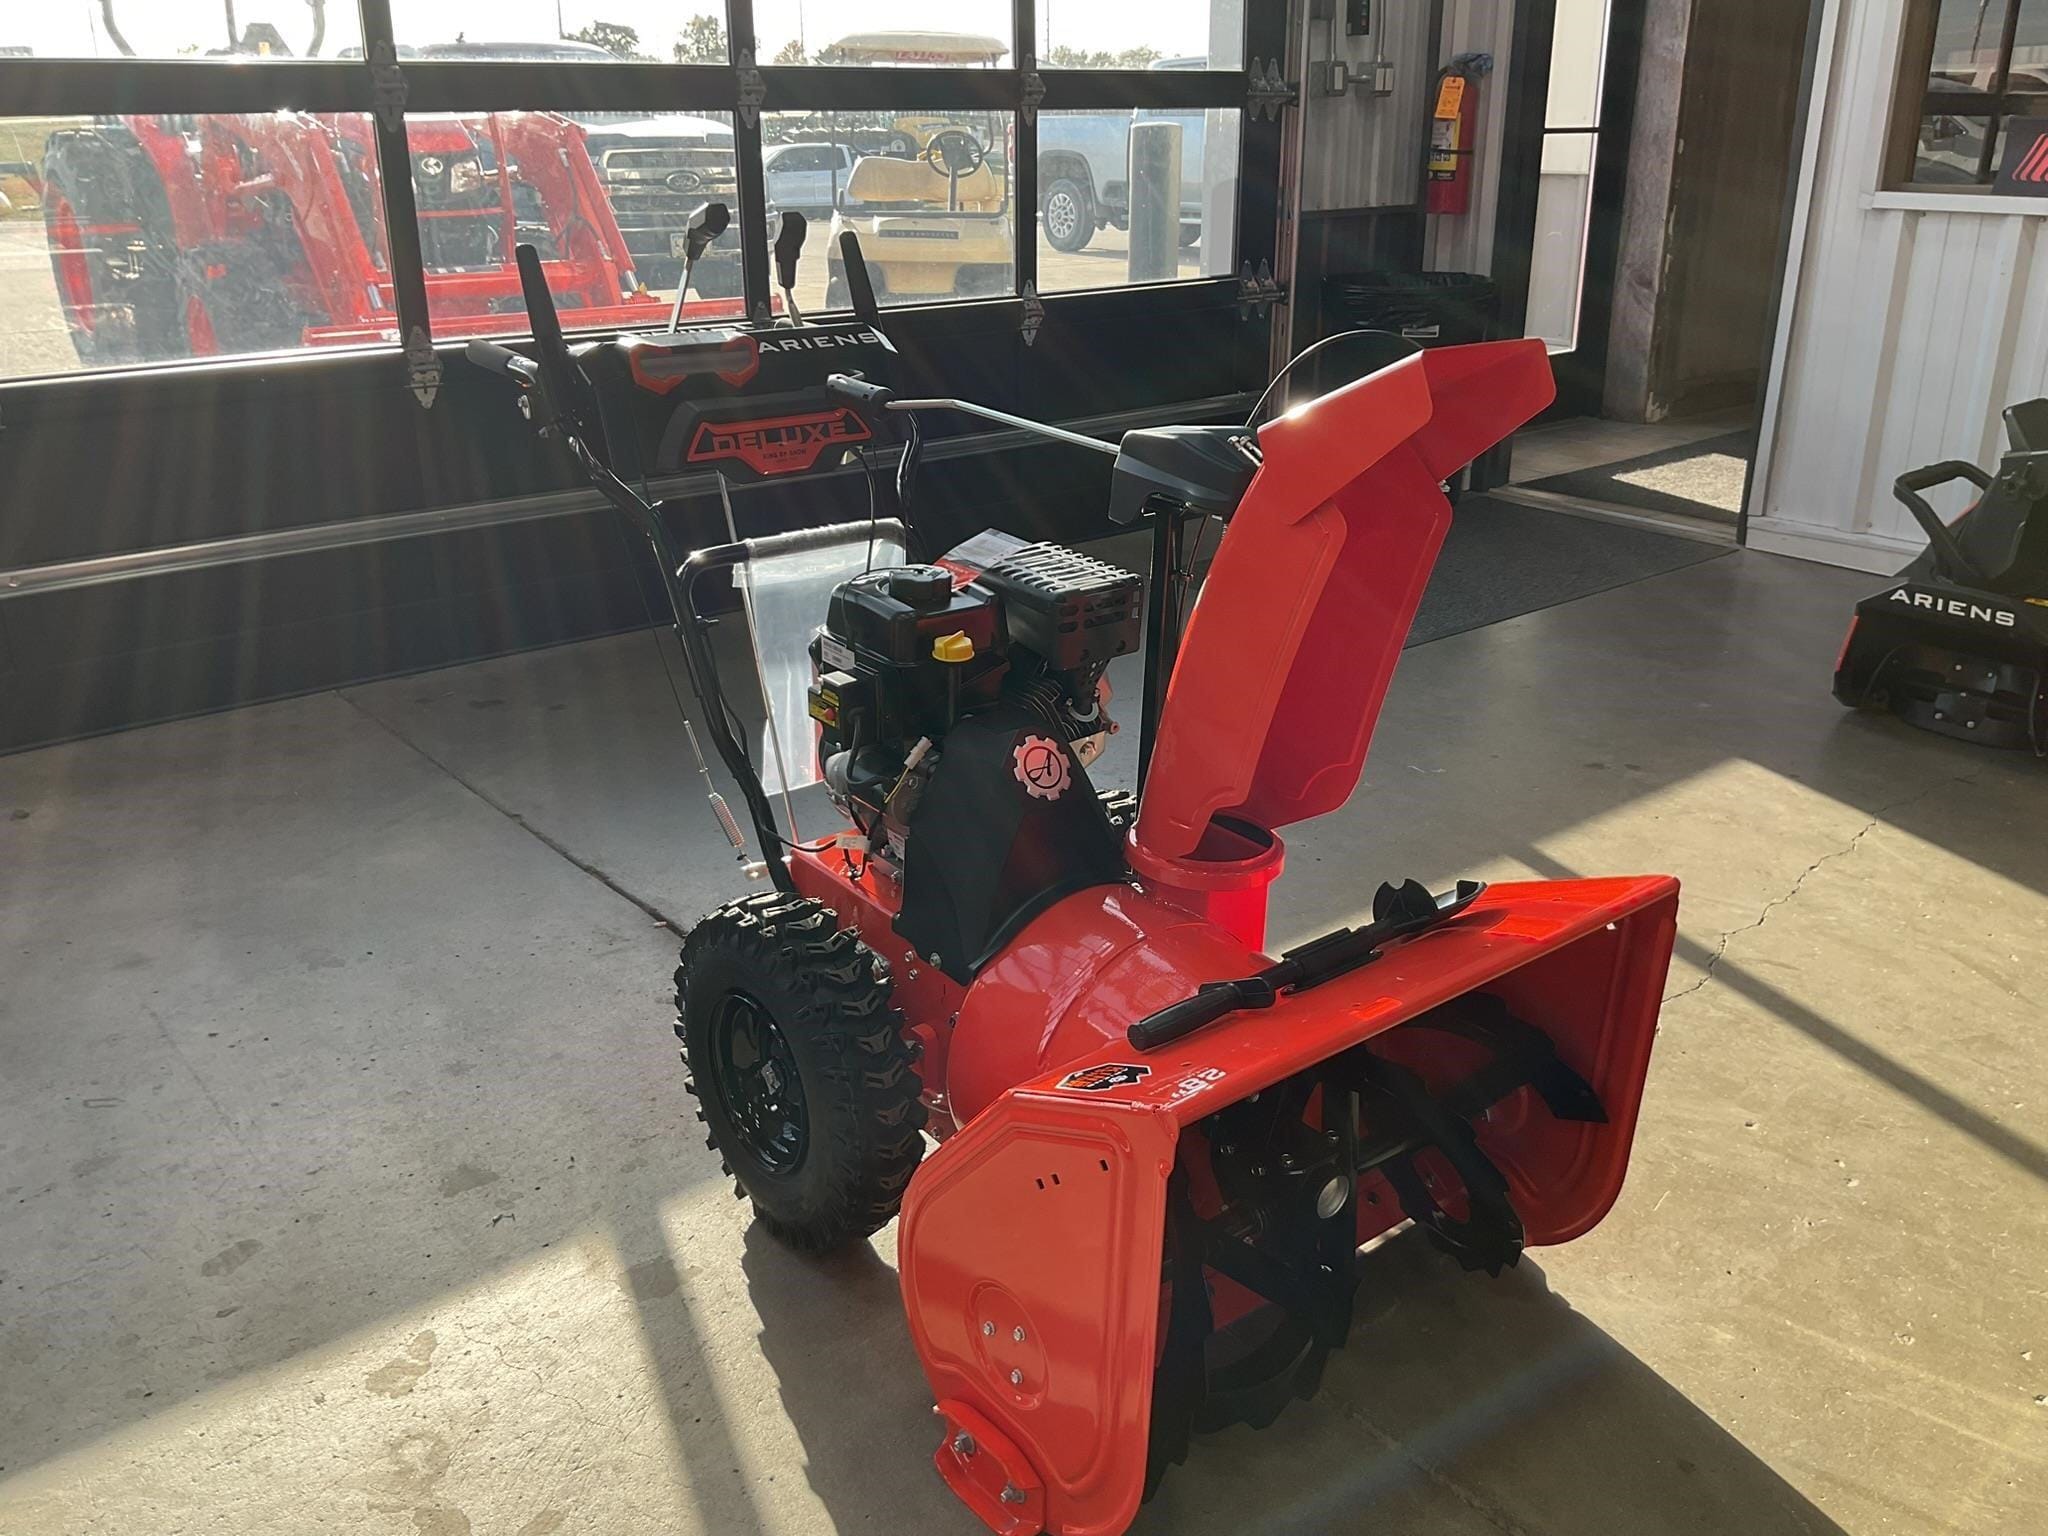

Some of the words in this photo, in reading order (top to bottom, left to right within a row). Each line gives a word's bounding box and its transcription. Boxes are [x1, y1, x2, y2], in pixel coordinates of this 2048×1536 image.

[758, 332, 880, 354] ARIENS
[713, 421, 846, 451] DELUXE
[1889, 589, 2016, 627] ARIENS
